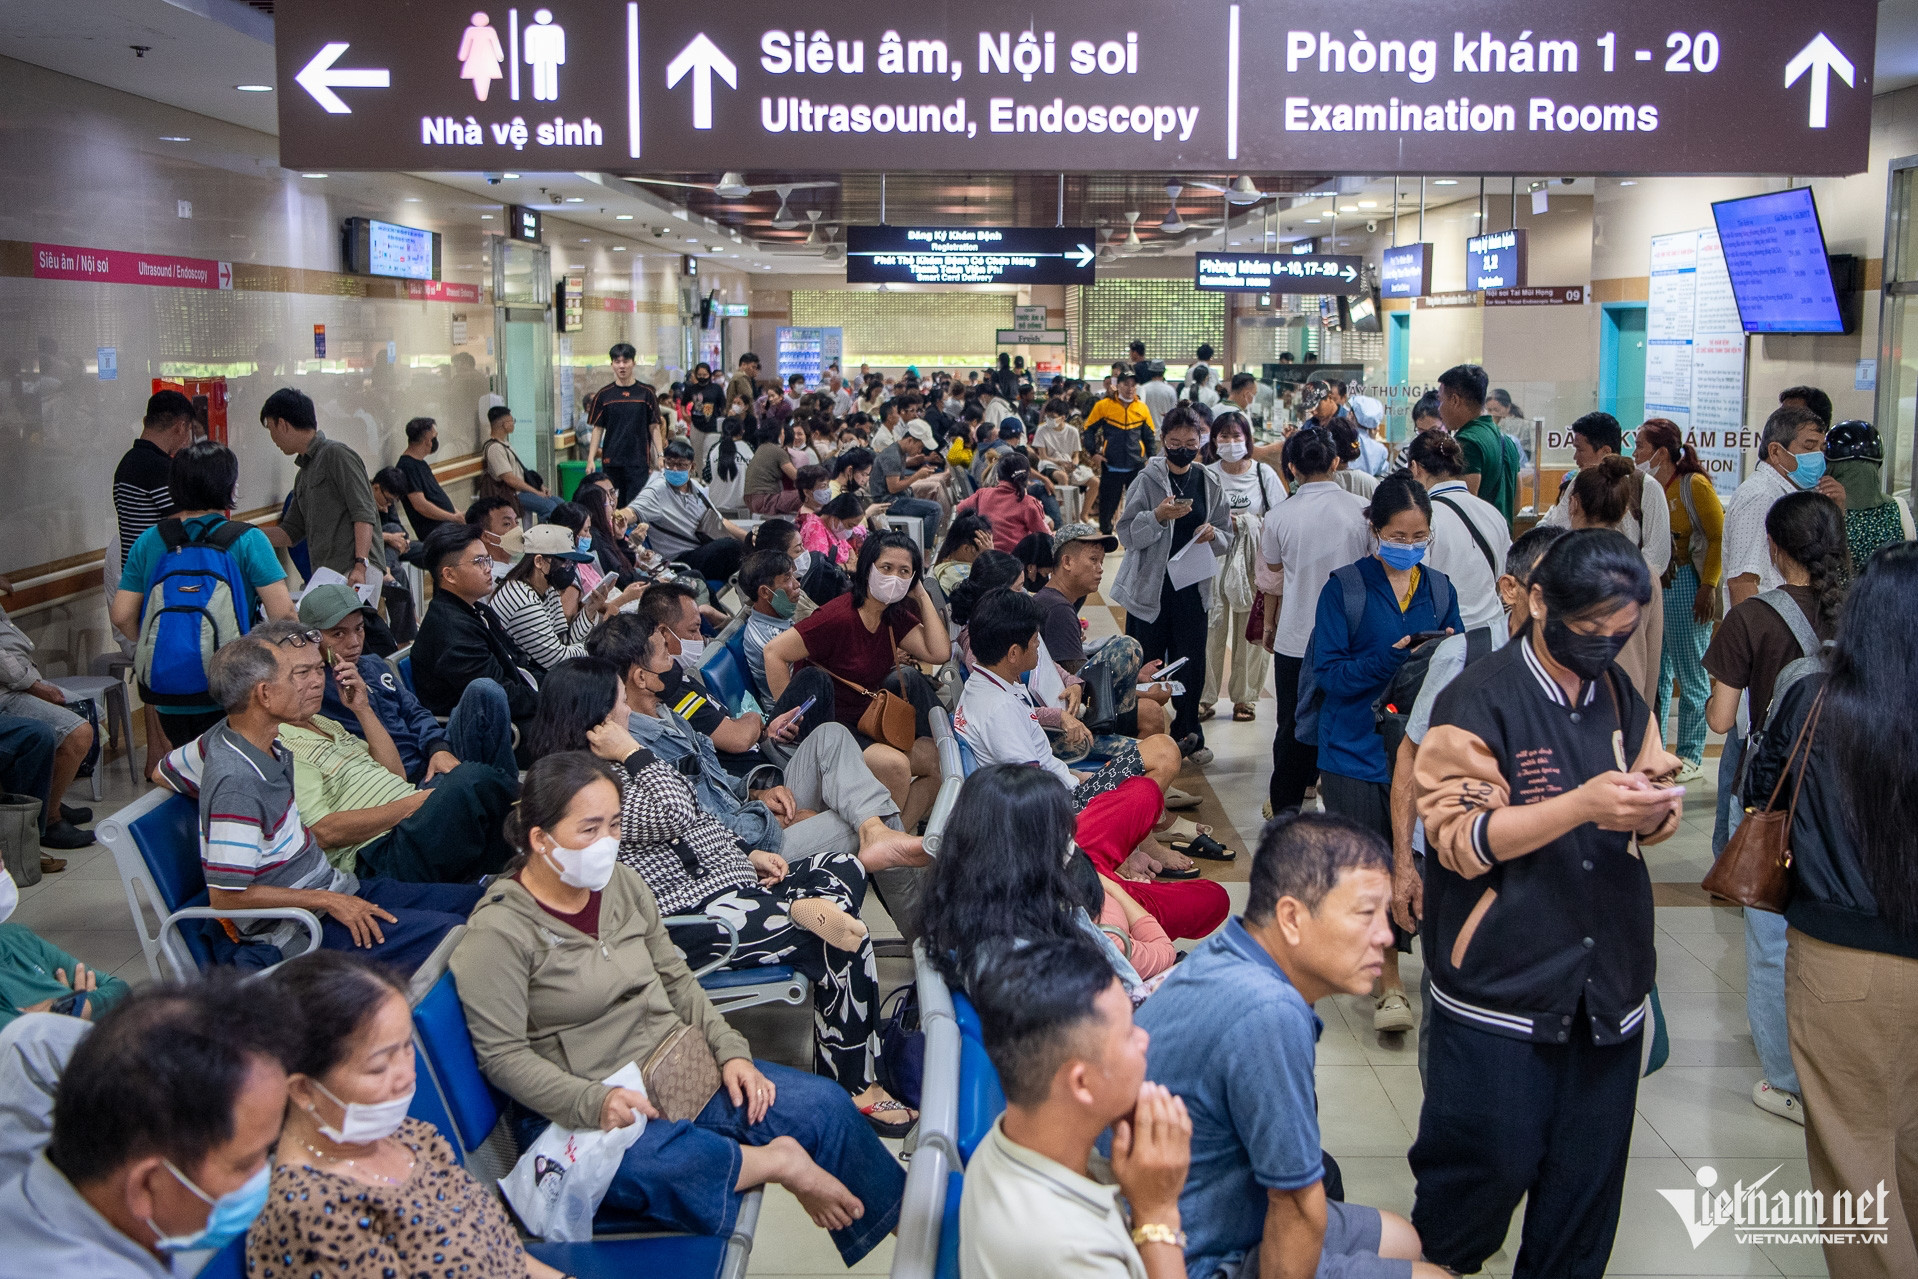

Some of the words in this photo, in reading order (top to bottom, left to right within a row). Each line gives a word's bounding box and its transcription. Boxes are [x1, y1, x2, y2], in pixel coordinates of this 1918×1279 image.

[760, 30, 864, 75] Siêu
[877, 30, 962, 81] âm,
[978, 31, 1055, 82] Nội
[1069, 31, 1138, 75] soi
[1285, 30, 1437, 83] Phòng
[1453, 30, 1579, 73] khám
[1596, 31, 1616, 72] 1
[1635, 49, 1652, 61] -
[1665, 31, 1720, 73] 20
[761, 97, 977, 139] Ultrasound,
[989, 98, 1200, 142] Endoscopy
[1284, 97, 1516, 132] Examination
[1528, 97, 1659, 132] Rooms
[421, 116, 484, 145] Nhà
[491, 116, 529, 151] vệ
[536, 117, 603, 146] sinh
[908, 231, 933, 242] Đăng
[934, 231, 947, 242] Ký
[948, 231, 976, 241] Khám
[977, 231, 1003, 242] Bệnh
[931, 243, 978, 253] Registration
[39, 250, 60, 269] Siêu
[61, 256, 75, 271] âm
[81, 255, 96, 275] Nội
[96, 257, 109, 273] soi
[1200, 259, 1237, 277] Phòng
[1238, 260, 1271, 274] khám
[138, 261, 173, 277] Ultrasound
[177, 265, 208, 283] Endoscopy
[917, 274, 940, 282] Smart
[941, 274, 960, 282] Card
[961, 274, 993, 283] Delivery
[1485, 289, 1497, 297] Nội
[1536, 289, 1554, 297] Họng
[1565, 290, 1580, 301] 09
[1018, 335, 1040, 343] Fresh
[1371, 386, 1397, 398] THU
